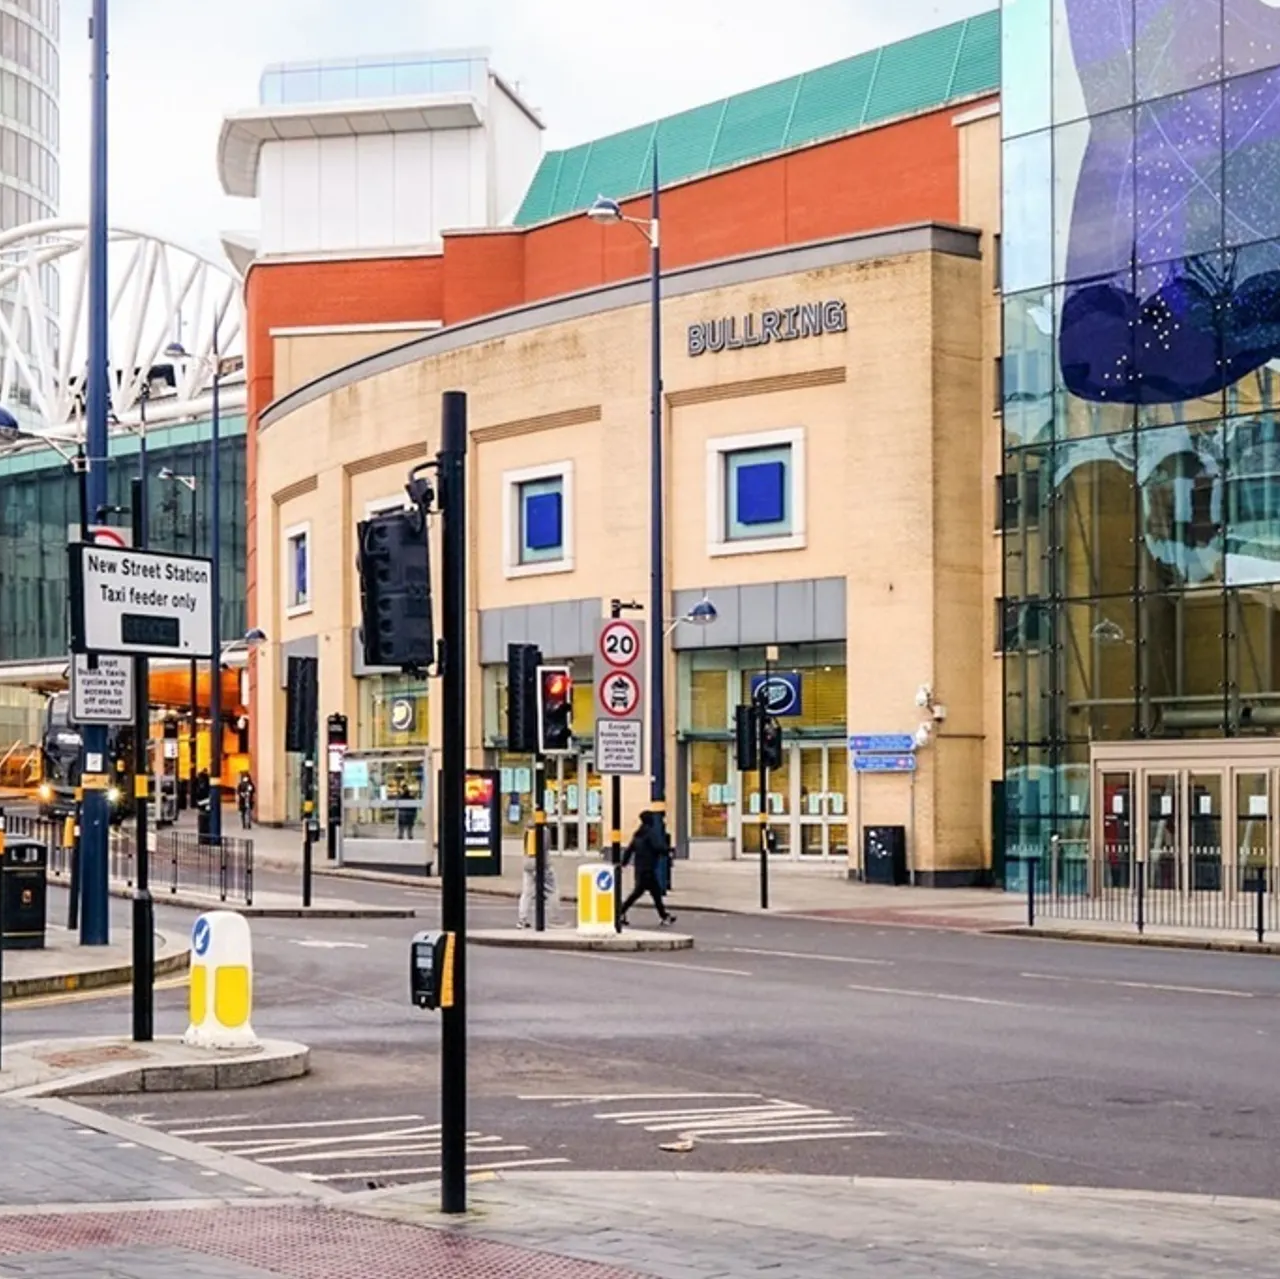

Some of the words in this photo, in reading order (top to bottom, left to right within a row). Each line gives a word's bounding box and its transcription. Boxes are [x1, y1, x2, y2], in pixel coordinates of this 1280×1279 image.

[688, 300, 848, 357] BULLRING
[88, 555, 117, 573] New
[121, 558, 161, 579] Street
[165, 563, 208, 583] Station
[101, 584, 125, 602] Taxi
[130, 587, 168, 606] feeder
[171, 593, 196, 612] only
[606, 634, 634, 654] 20
